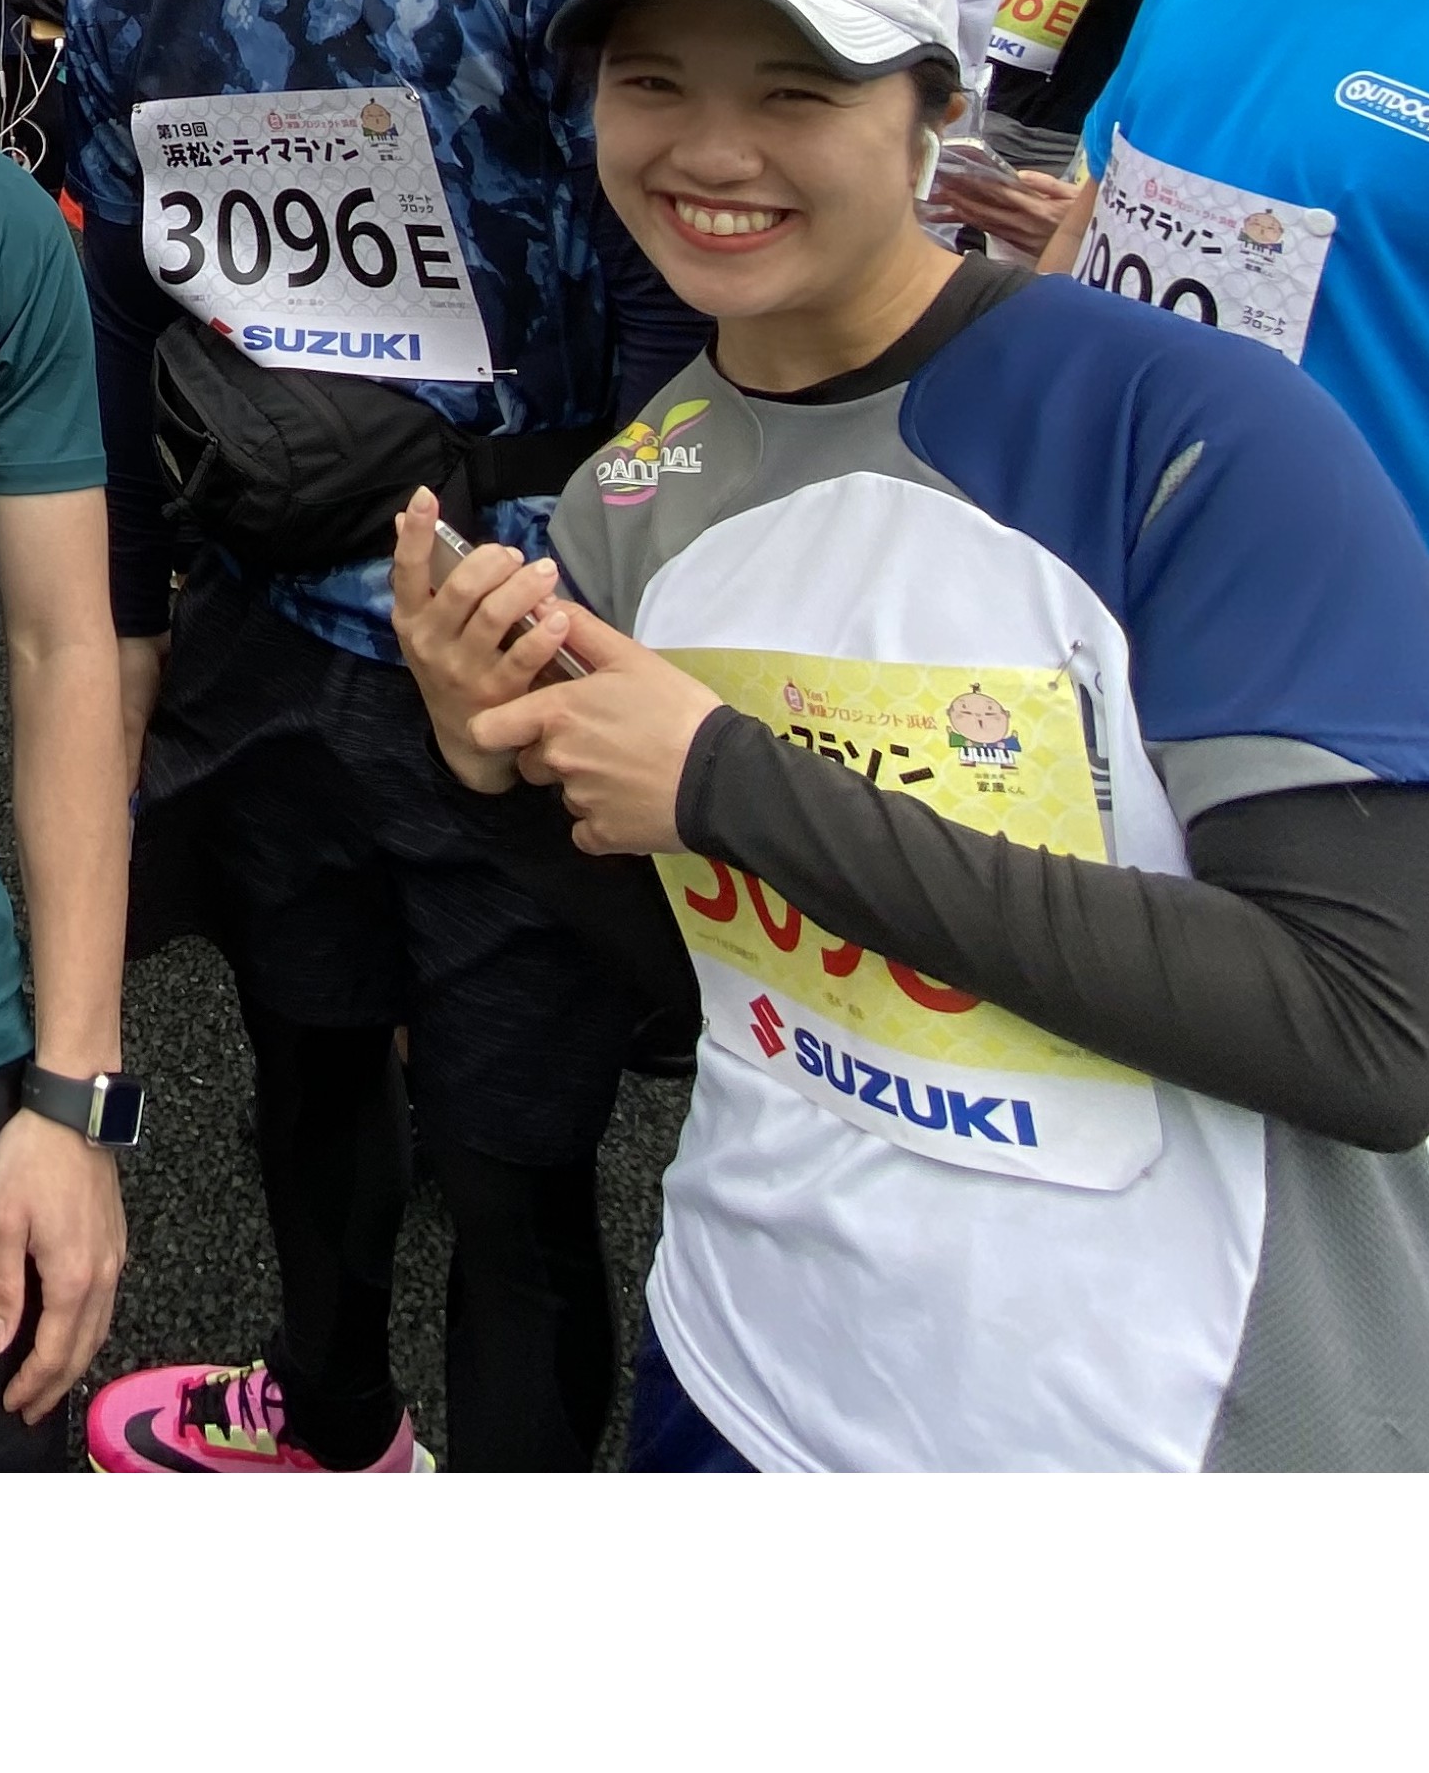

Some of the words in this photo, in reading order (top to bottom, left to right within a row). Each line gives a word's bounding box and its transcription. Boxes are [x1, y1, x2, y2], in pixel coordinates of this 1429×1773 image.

[1043, 0, 1080, 37] E
[157, 121, 207, 139] 第19回
[161, 138, 359, 168] 浜松シティマラソン
[159, 187, 398, 288] 3096
[405, 224, 461, 290] E
[243, 325, 421, 361] SUZUKI
[795, 1027, 1038, 1149] SUZUKI
